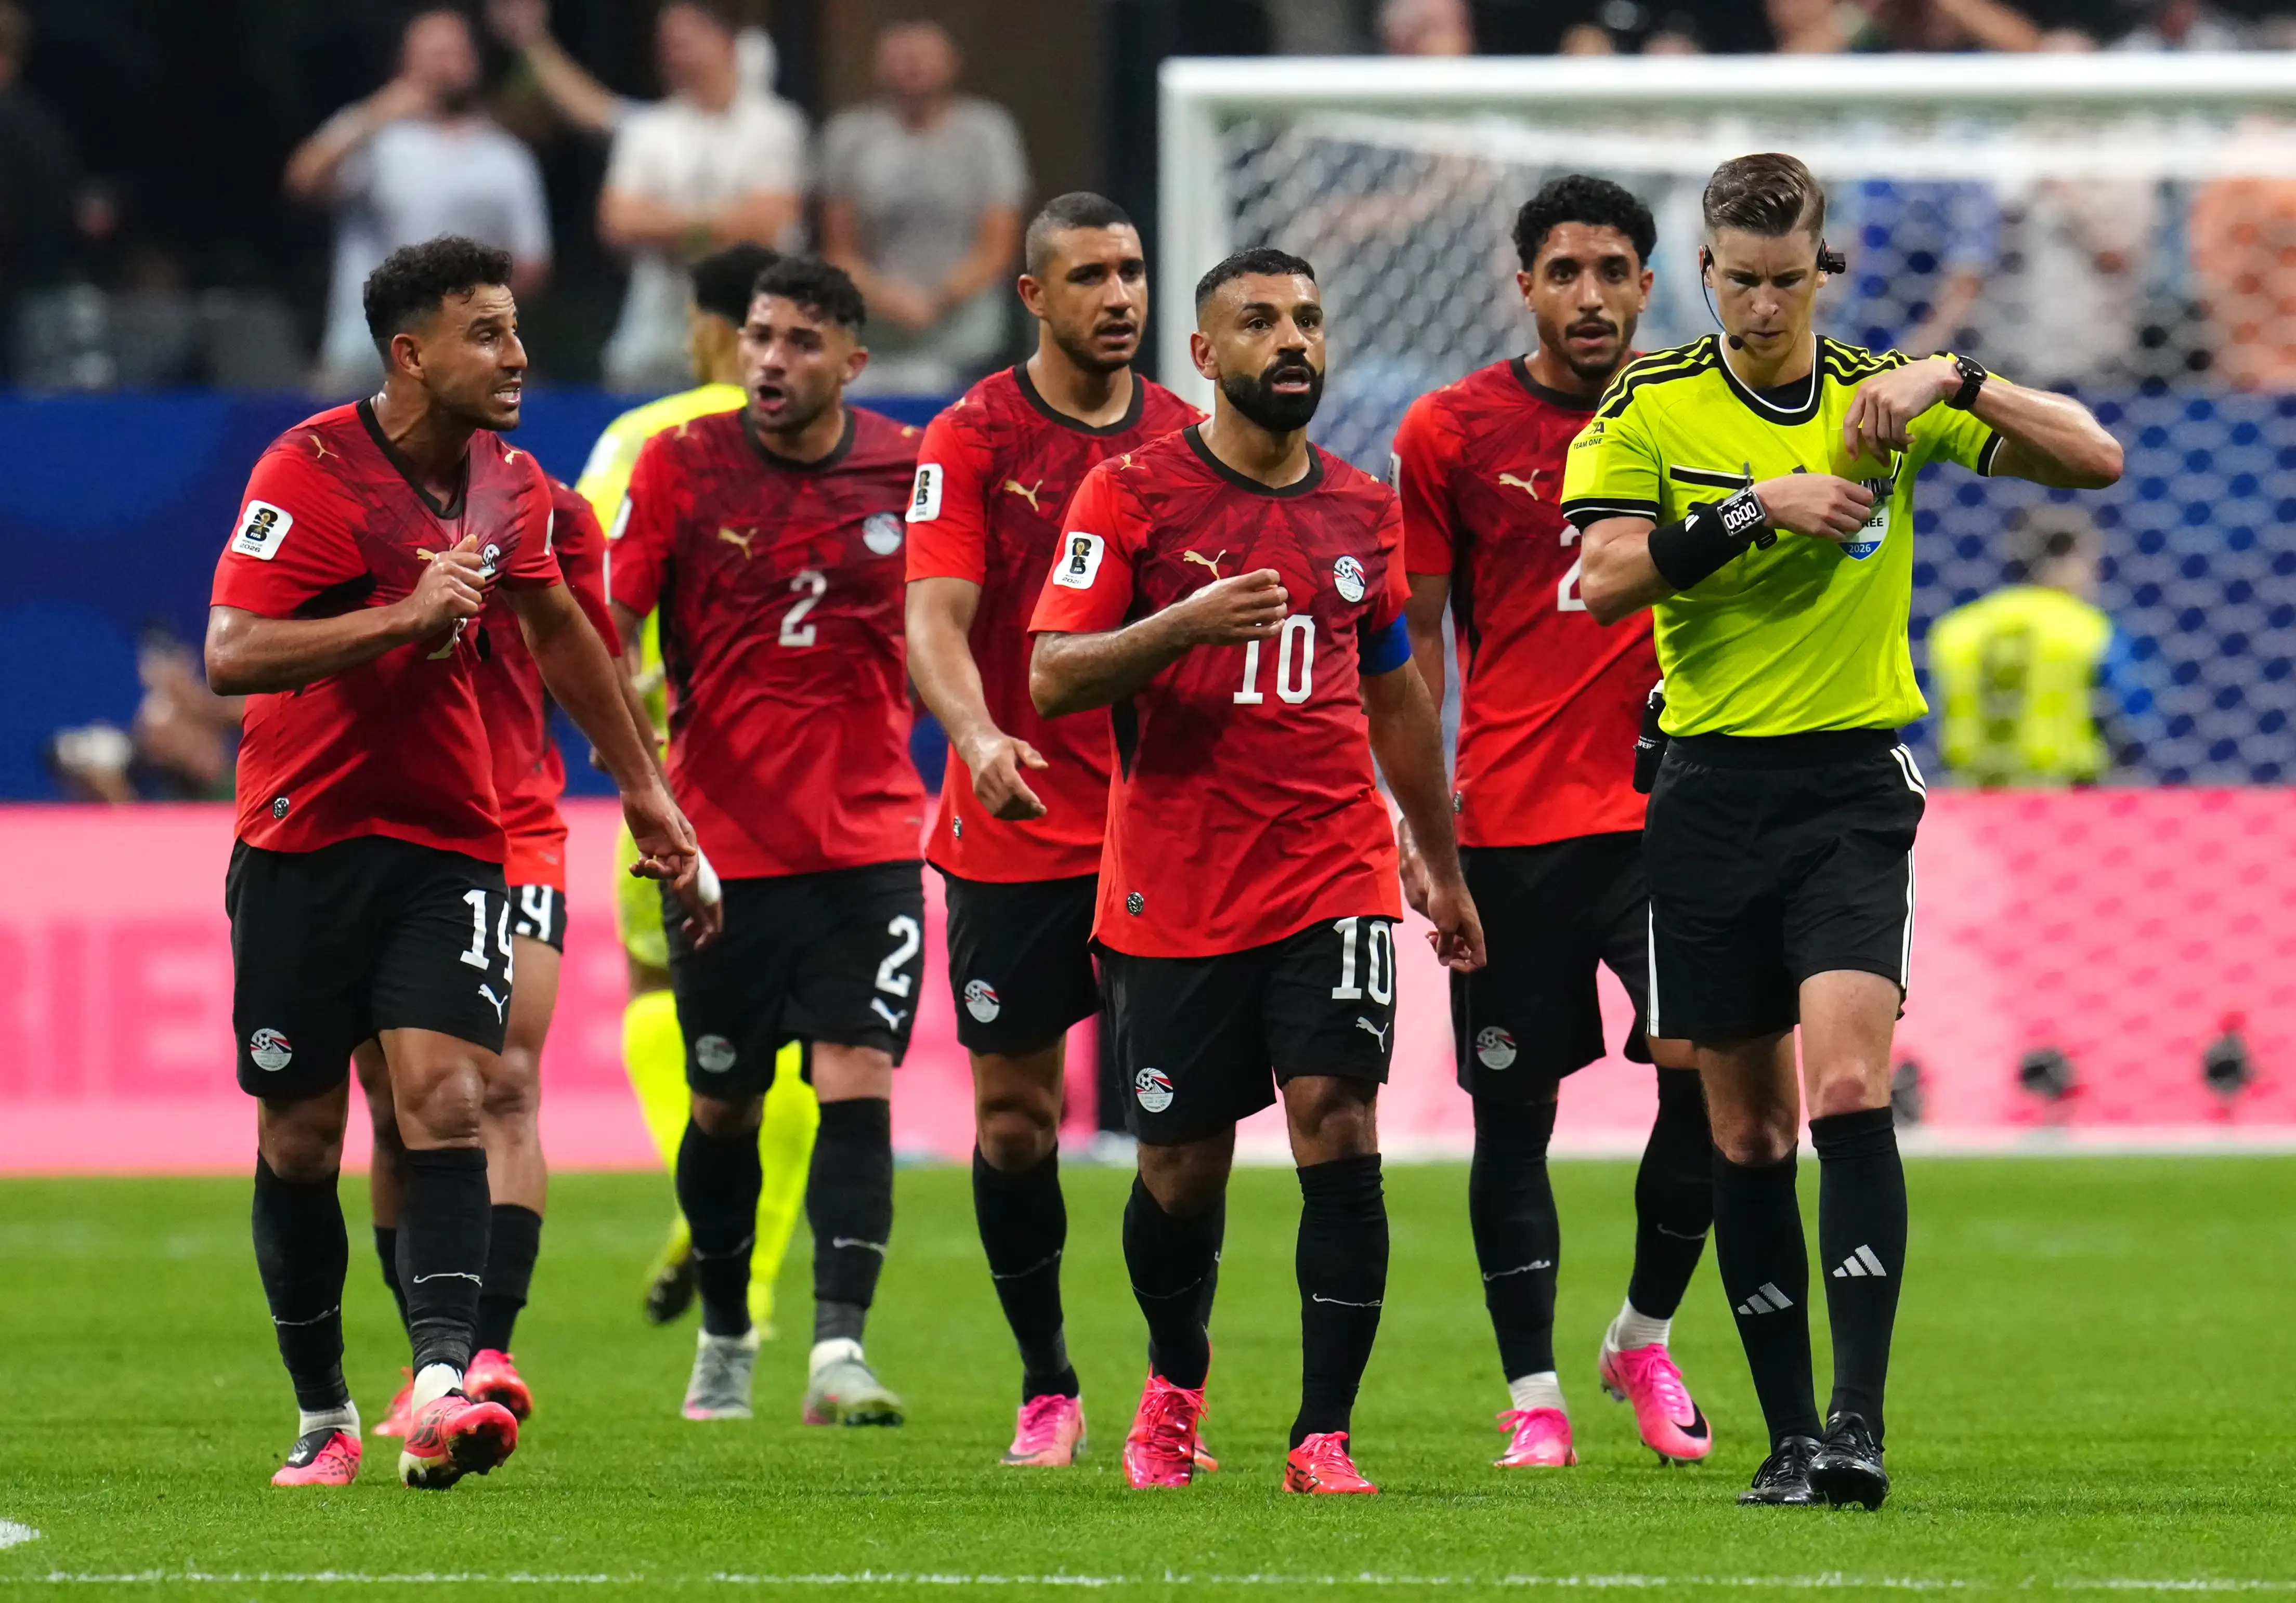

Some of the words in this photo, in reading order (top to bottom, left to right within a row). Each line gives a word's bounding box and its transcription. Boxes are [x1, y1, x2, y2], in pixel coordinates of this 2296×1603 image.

[1573, 440, 1587, 450] TEAM
[1724, 502, 1757, 529] 00:00
[239, 542, 262, 553] 2026
[1848, 544, 1871, 554] 2026
[778, 570, 827, 647] 2
[1233, 612, 1315, 704] 10
[875, 915, 920, 998] 2
[1332, 916, 1392, 1006] 10
